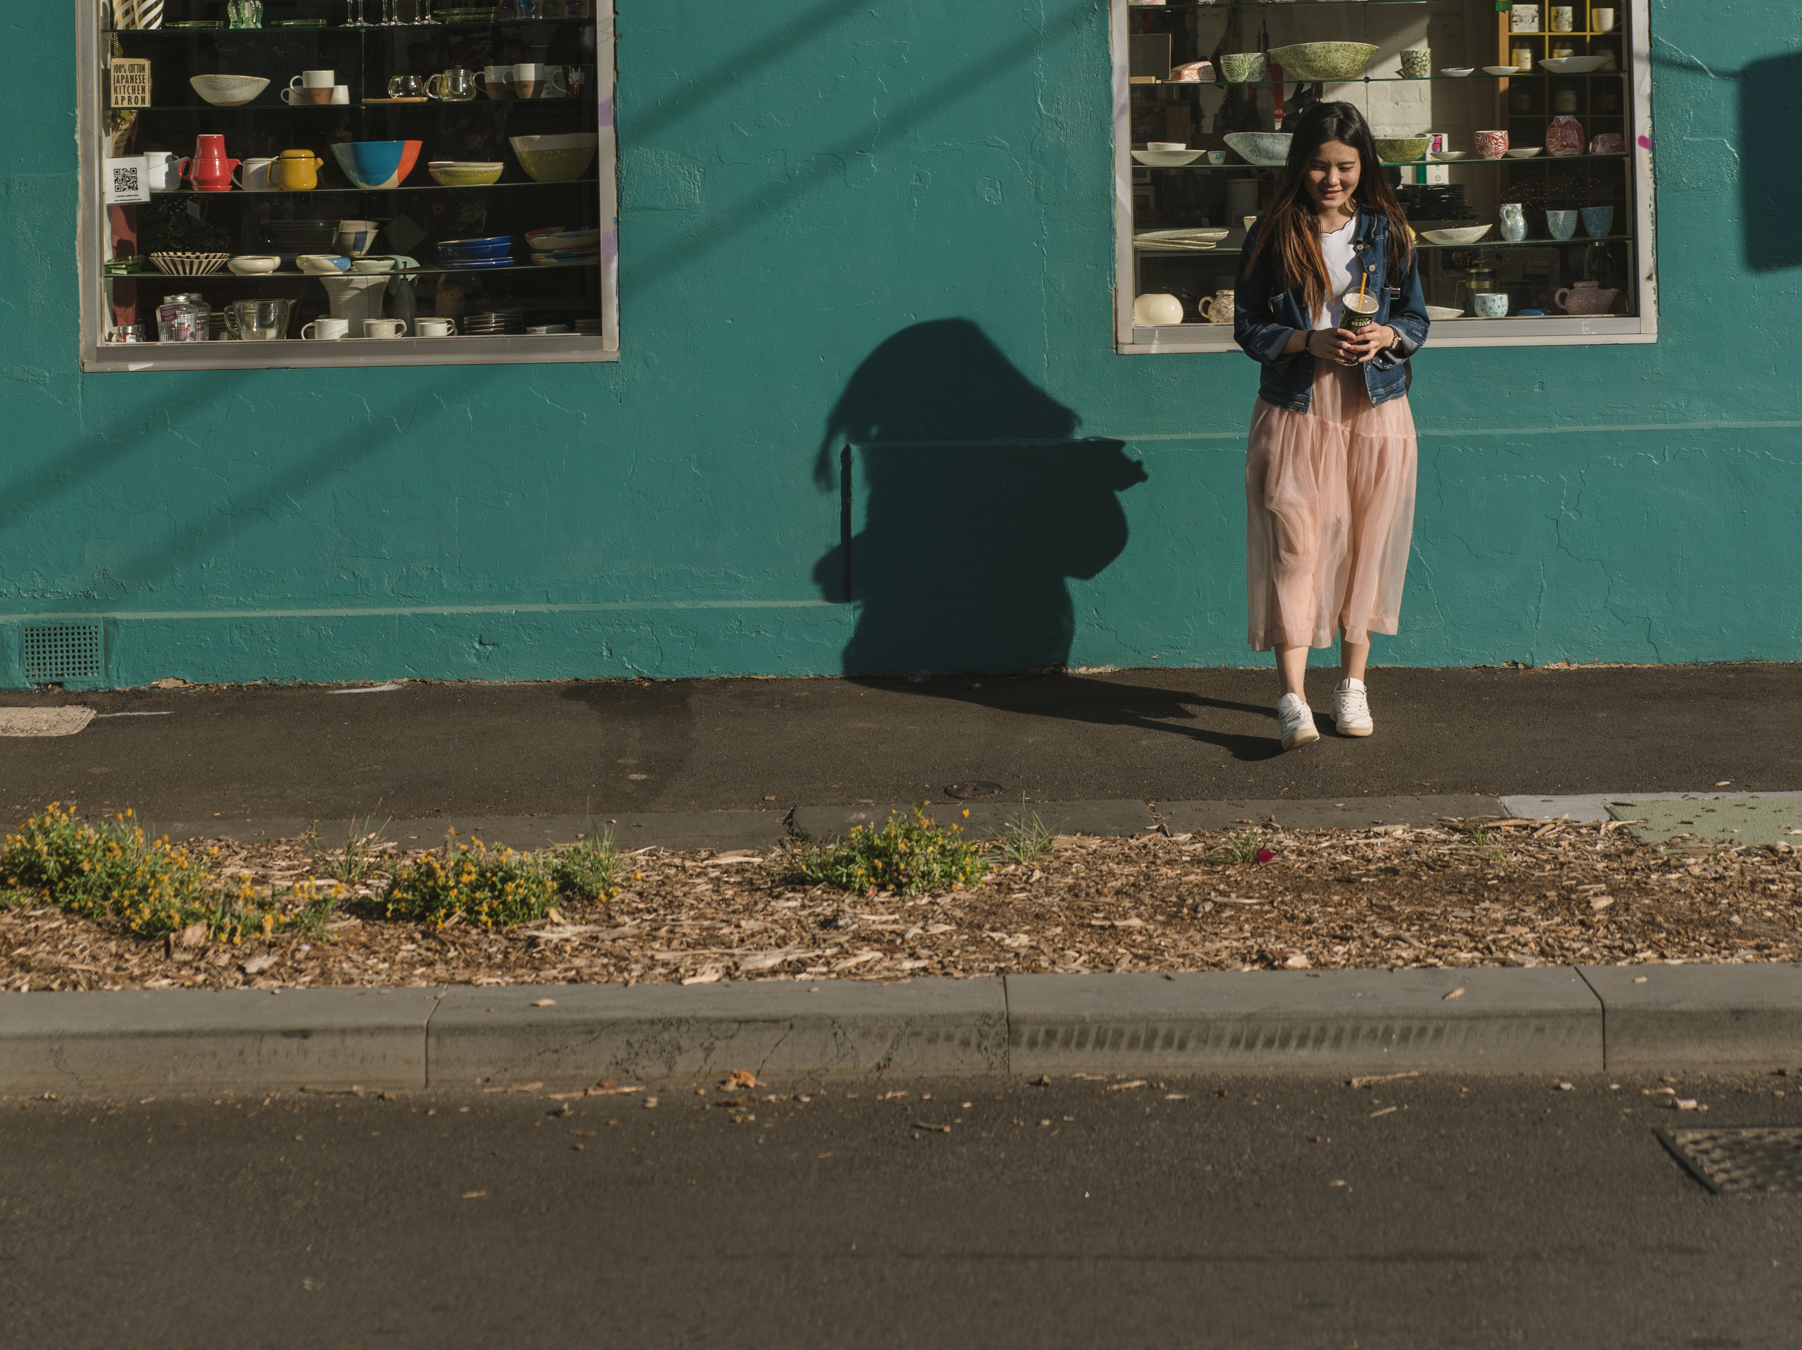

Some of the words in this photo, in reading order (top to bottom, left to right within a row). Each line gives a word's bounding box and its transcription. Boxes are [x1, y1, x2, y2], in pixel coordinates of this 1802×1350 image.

[113, 63, 127, 73] 100%
[128, 63, 146, 73] COTTON
[113, 74, 146, 85] JAPANESE
[113, 84, 146, 95] KITCHEN
[114, 95, 146, 105] APRON
